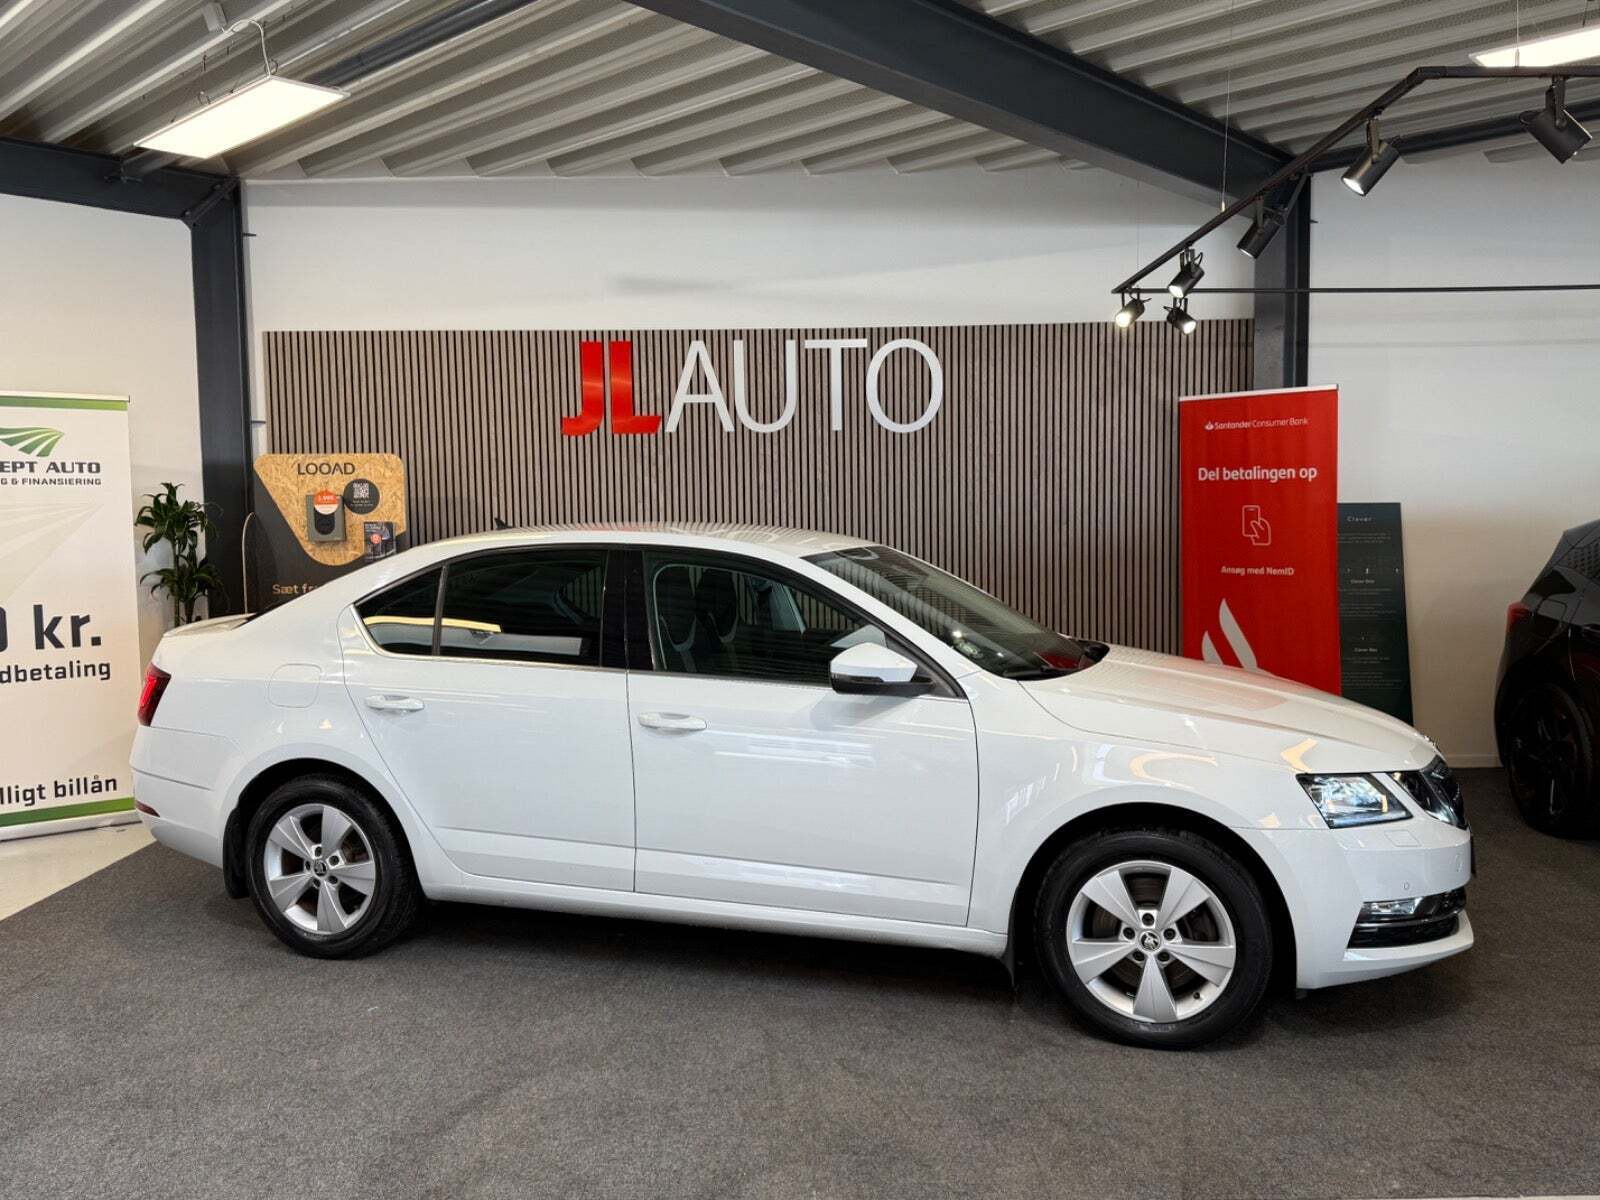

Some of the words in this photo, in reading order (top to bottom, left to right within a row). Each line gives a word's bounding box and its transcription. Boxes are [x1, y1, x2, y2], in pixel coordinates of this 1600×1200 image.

[561, 340, 662, 437] JL
[664, 338, 943, 433] AUTO
[46, 461, 101, 474] AUTO
[297, 463, 356, 475] LOOAD
[1198, 467, 1220, 481] Del
[1222, 465, 1296, 483] betalingen
[1299, 466, 1318, 482] op
[21, 478, 102, 486] FINANSIERING
[1246, 566, 1265, 575] med
[33, 604, 102, 650] kr.
[53, 774, 118, 798] billån
